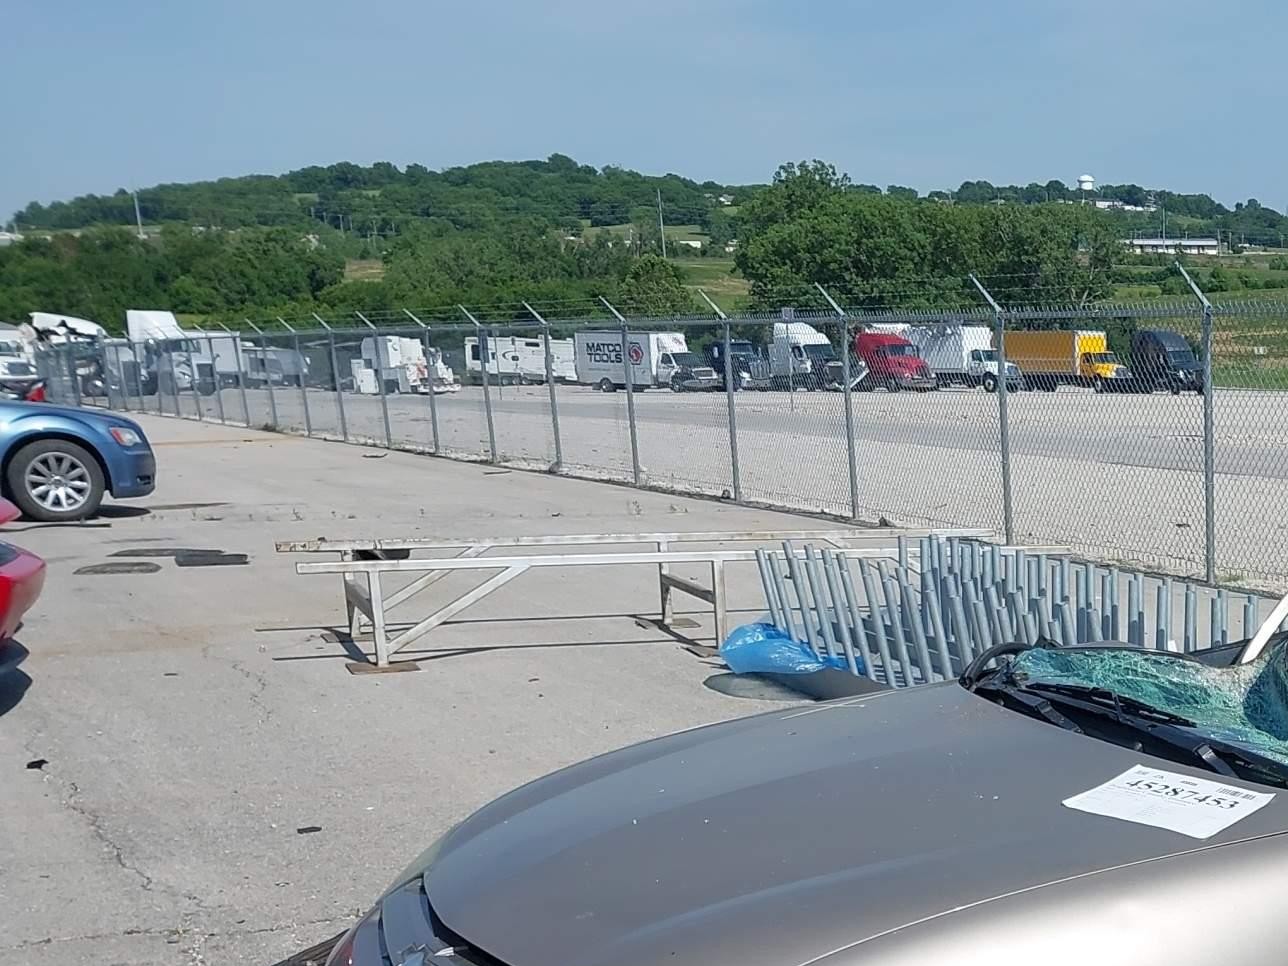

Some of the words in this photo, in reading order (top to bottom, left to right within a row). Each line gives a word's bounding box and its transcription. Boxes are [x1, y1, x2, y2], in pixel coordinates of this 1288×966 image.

[586, 342, 622, 352] MATCO
[586, 352, 623, 363] TOOLS
[1126, 779, 1240, 810] 45287453
